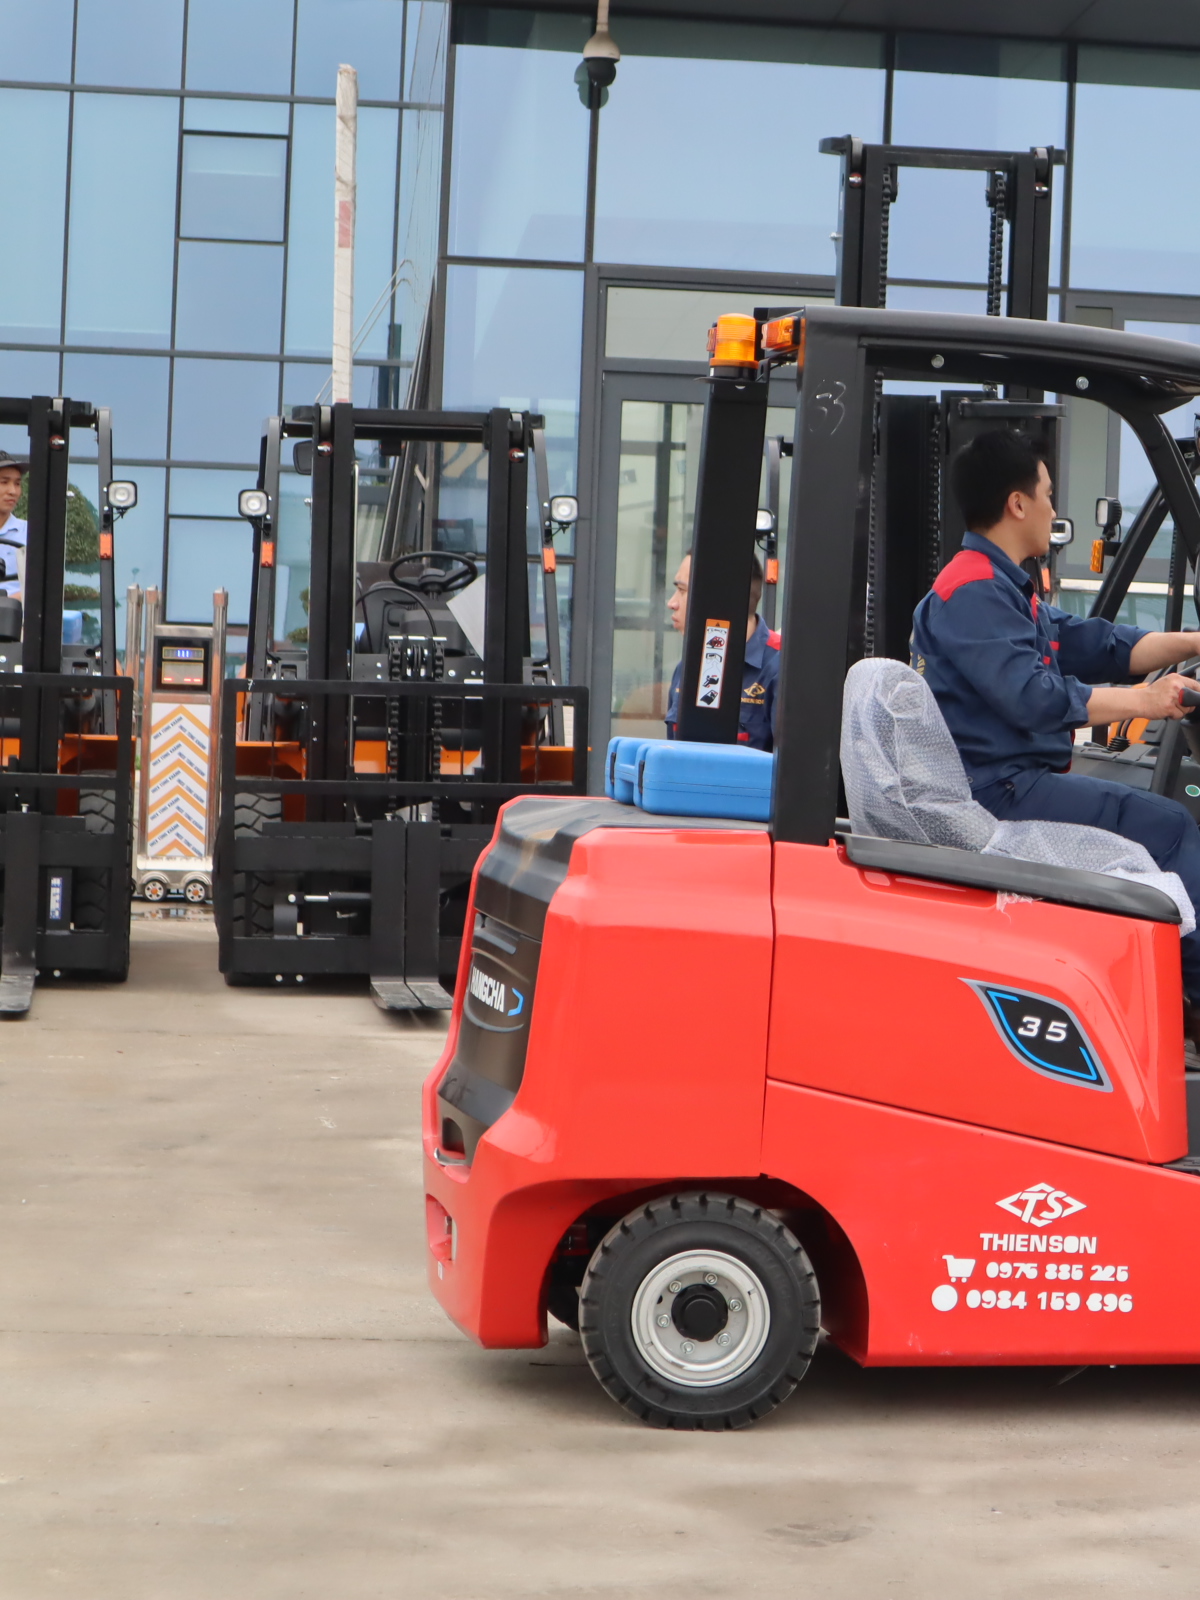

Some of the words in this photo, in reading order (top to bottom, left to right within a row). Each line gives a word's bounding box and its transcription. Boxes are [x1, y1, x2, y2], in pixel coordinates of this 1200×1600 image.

[1018, 1016, 1068, 1042] 35
[979, 1233, 1097, 1254] THIENSON
[1044, 1263, 1084, 1281] 885
[1089, 1265, 1129, 1282] 225
[966, 1289, 1027, 1309] 0984
[1037, 1291, 1080, 1311] 159
